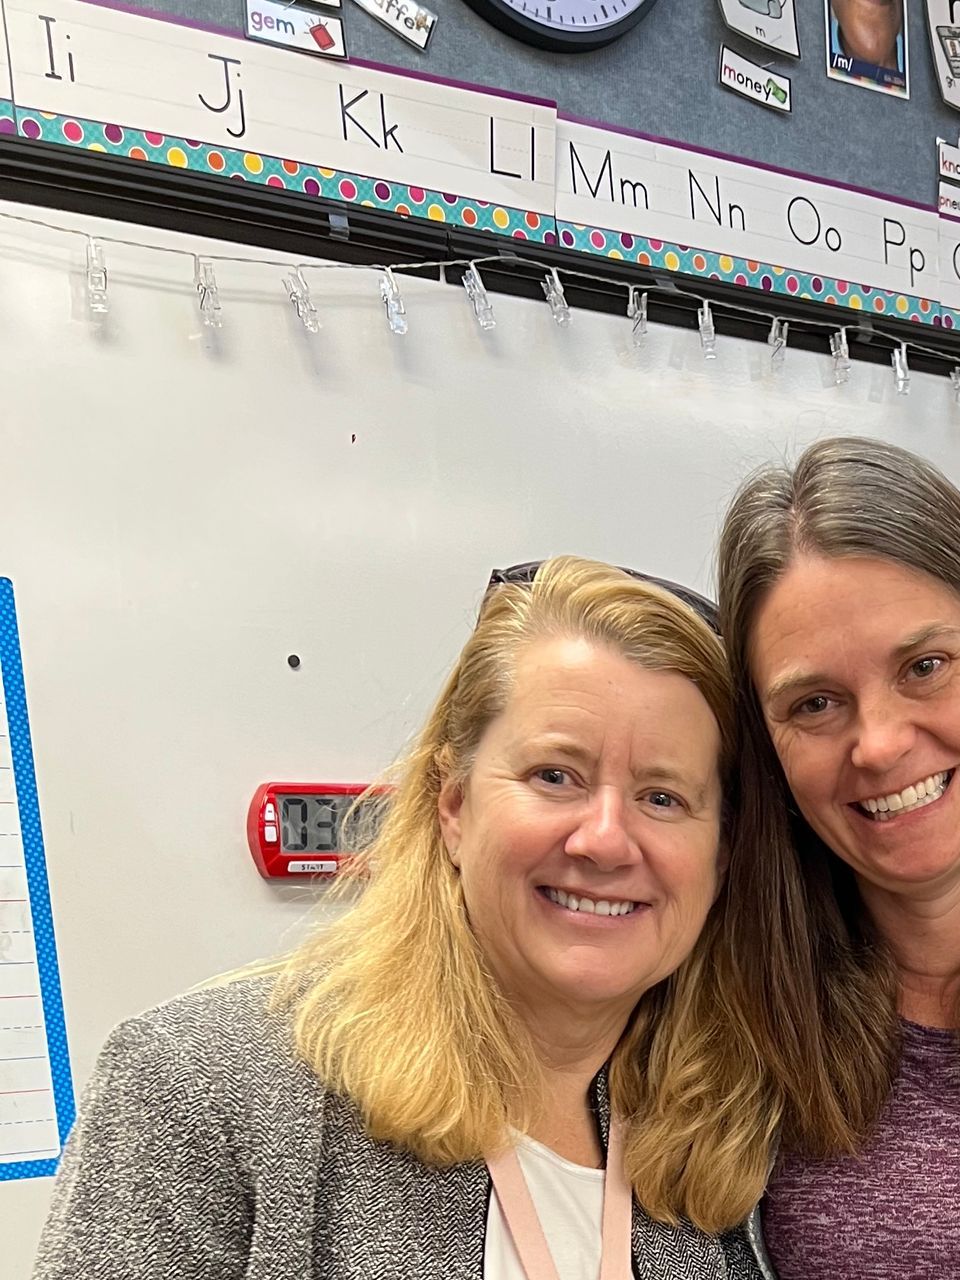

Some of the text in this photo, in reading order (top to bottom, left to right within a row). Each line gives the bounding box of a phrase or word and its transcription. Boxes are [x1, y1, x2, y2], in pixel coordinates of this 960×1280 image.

[251, 11, 295, 36] gem
[723, 62, 772, 101] money
[832, 53, 853, 72] /m/
[38, 15, 76, 83] Ii
[198, 53, 247, 138] Jj
[338, 83, 404, 154] Kk
[568, 140, 926, 288] Mm Nn Oo Pp
